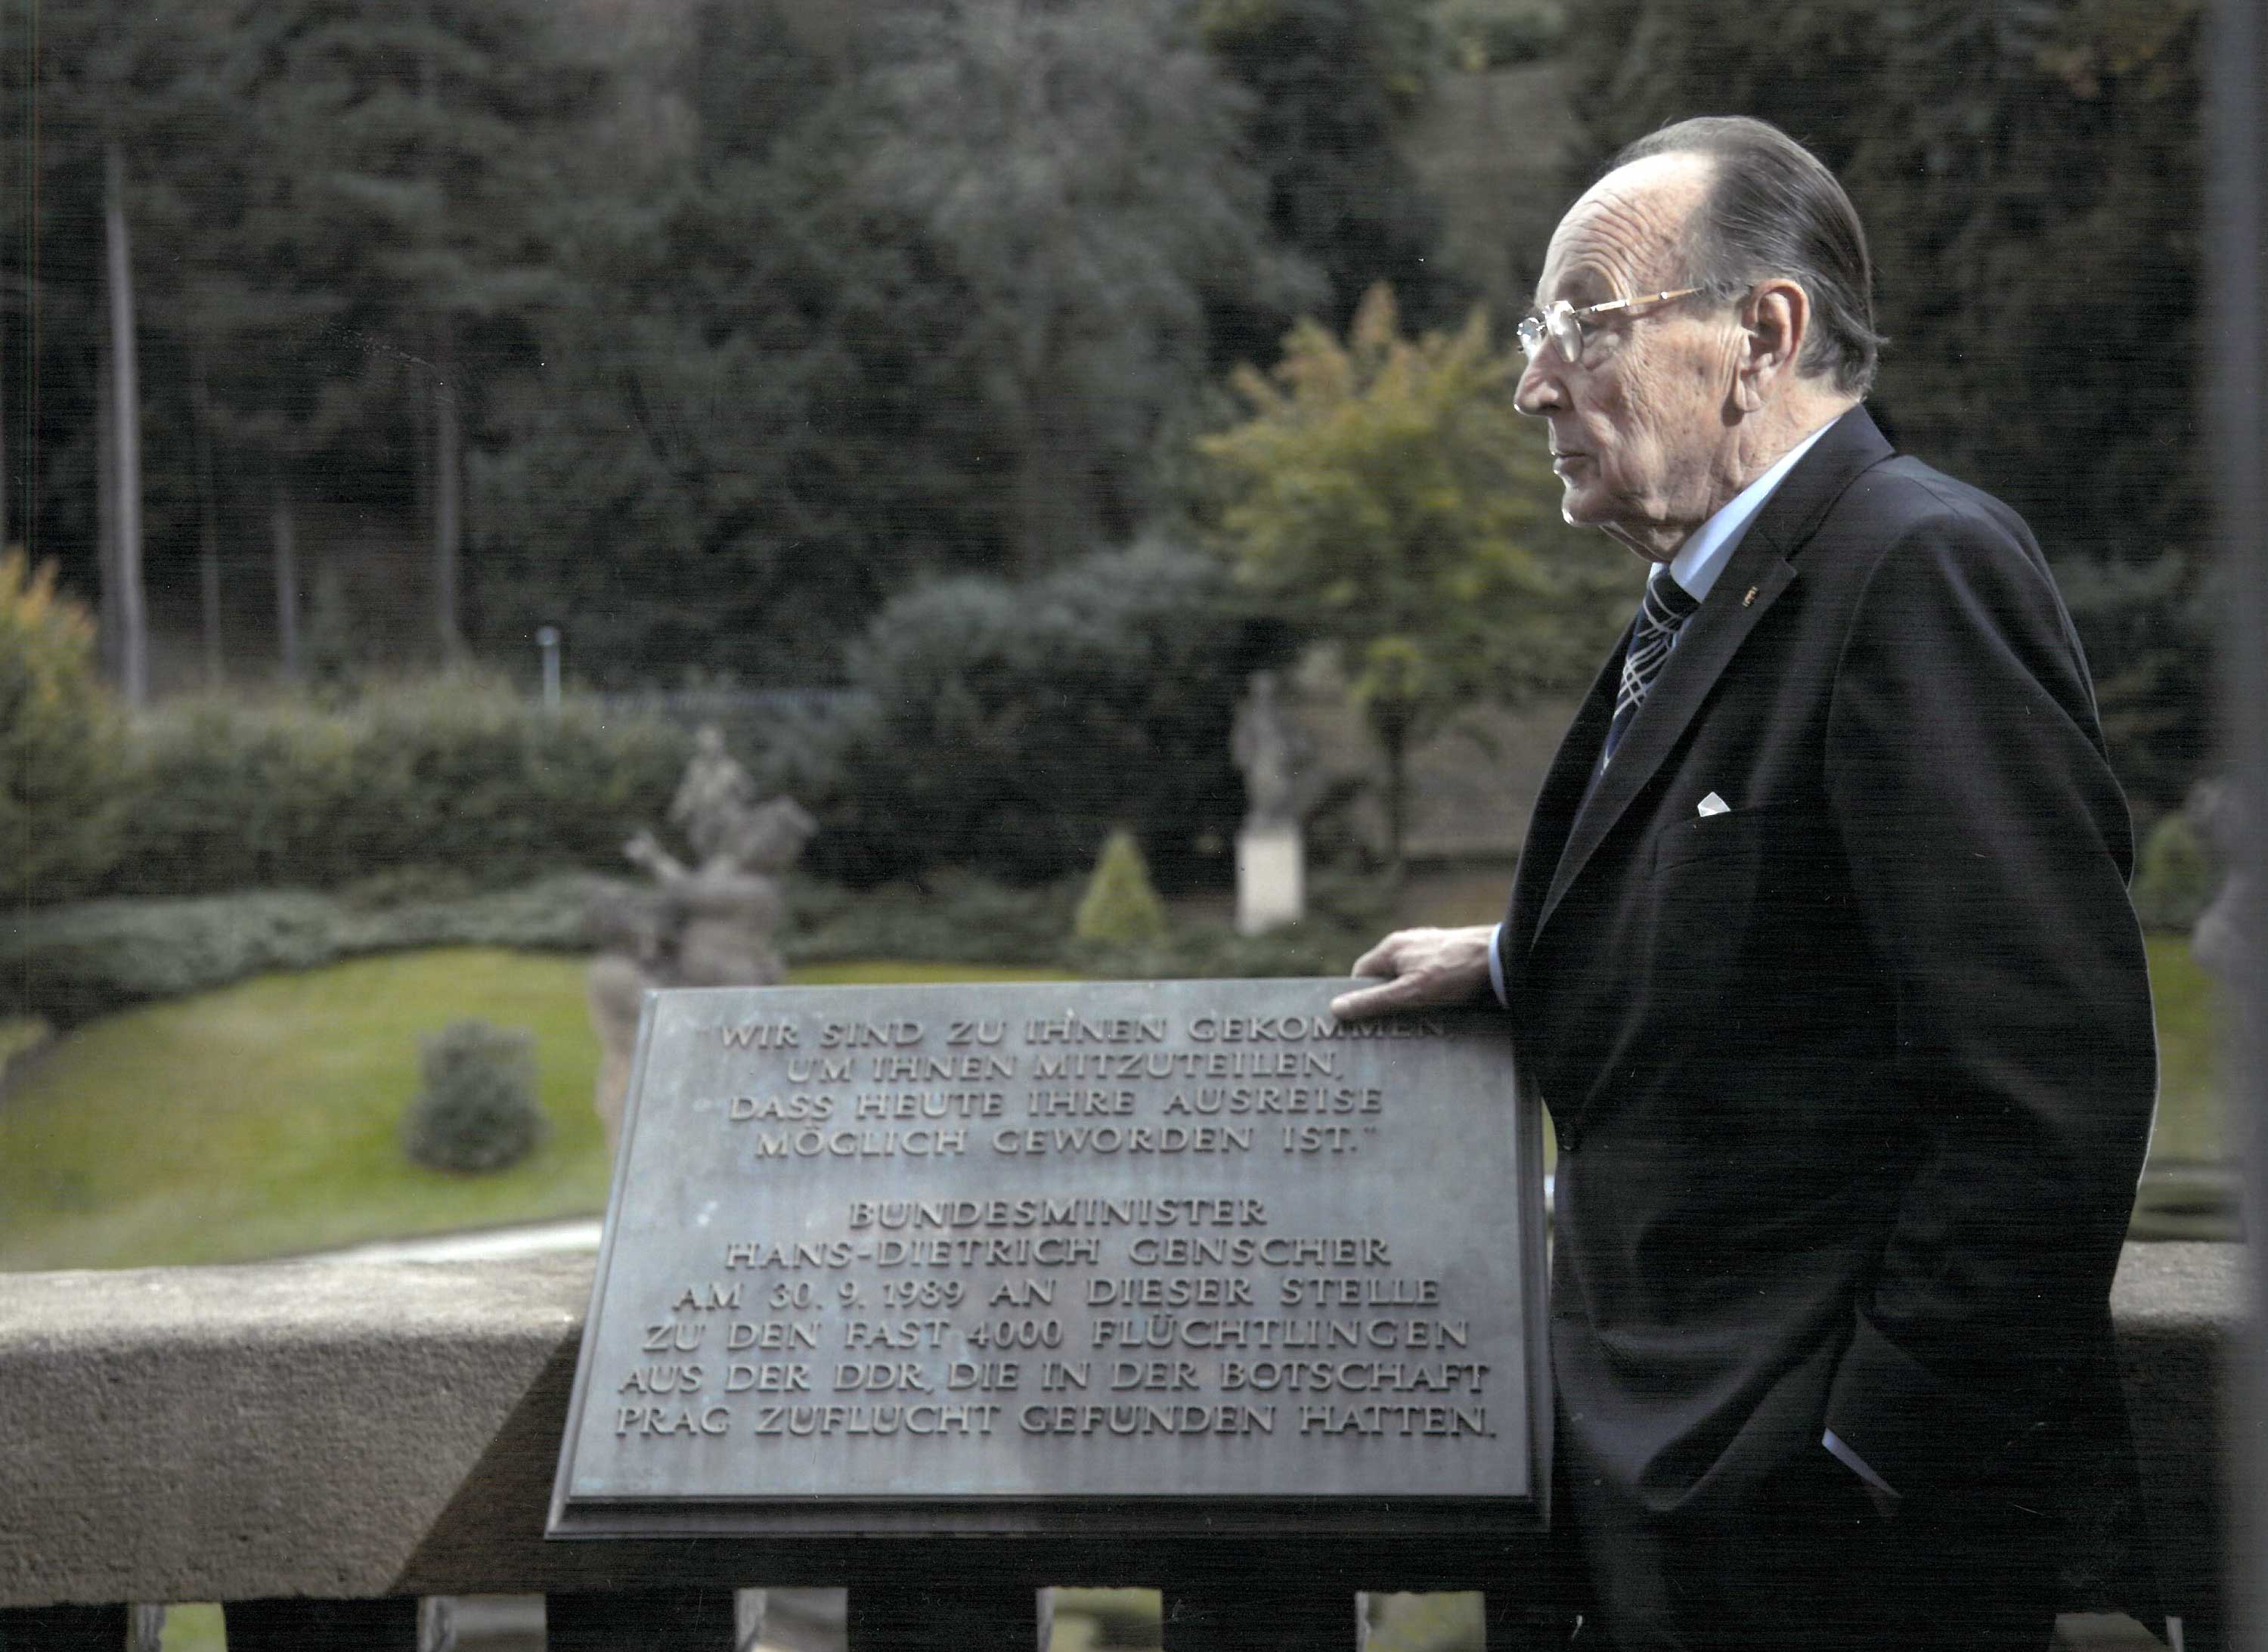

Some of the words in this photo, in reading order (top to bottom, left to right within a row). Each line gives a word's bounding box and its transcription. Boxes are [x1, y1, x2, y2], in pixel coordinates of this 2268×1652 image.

[819, 1021, 925, 1050] SIND
[946, 1021, 1006, 1048] ZU
[1024, 1017, 1168, 1046] IHNEN
[785, 1058, 851, 1084] UM
[871, 1055, 1018, 1081] IHNEN
[1033, 1052, 1346, 1081] MITZUTEILEN,
[728, 1093, 834, 1122] DASS
[855, 1092, 1005, 1120] HEUTE
[1027, 1089, 1135, 1117] IHRE
[1163, 1087, 1383, 1116] AUSREISE
[755, 1123, 966, 1158] MÖGLICH
[993, 1127, 1254, 1156] GEWORDEN
[849, 1198, 1268, 1229] BUNDESMINISTER
[725, 1238, 1100, 1270] HANS-DIETRICH
[1129, 1238, 1392, 1266] GENSCHER
[672, 1282, 743, 1311] AM
[881, 1280, 966, 1307] 1989
[989, 1279, 1058, 1306] AN
[1086, 1278, 1255, 1306] DIESER
[1279, 1278, 1441, 1306] STELLE
[642, 1323, 706, 1352] ZU
[726, 1322, 823, 1350] DEN
[844, 1321, 953, 1349] FAST
[967, 1320, 1064, 1348] 4000
[1091, 1313, 1471, 1349] FLÜCHTLINGEN
[618, 1364, 703, 1394] AUS
[723, 1364, 812, 1393] DER
[832, 1362, 936, 1394] DDR,
[947, 1362, 1019, 1391] DIE
[1040, 1362, 1092, 1390] IN
[1111, 1361, 1201, 1391] DER
[1219, 1361, 1492, 1393] BOTSCHAFT
[615, 1406, 731, 1437] PRAG
[754, 1406, 1004, 1436] ZUFLUCHT
[1018, 1405, 1279, 1436] GEFUNDEN
[1298, 1404, 1497, 1437] HATTEN.
